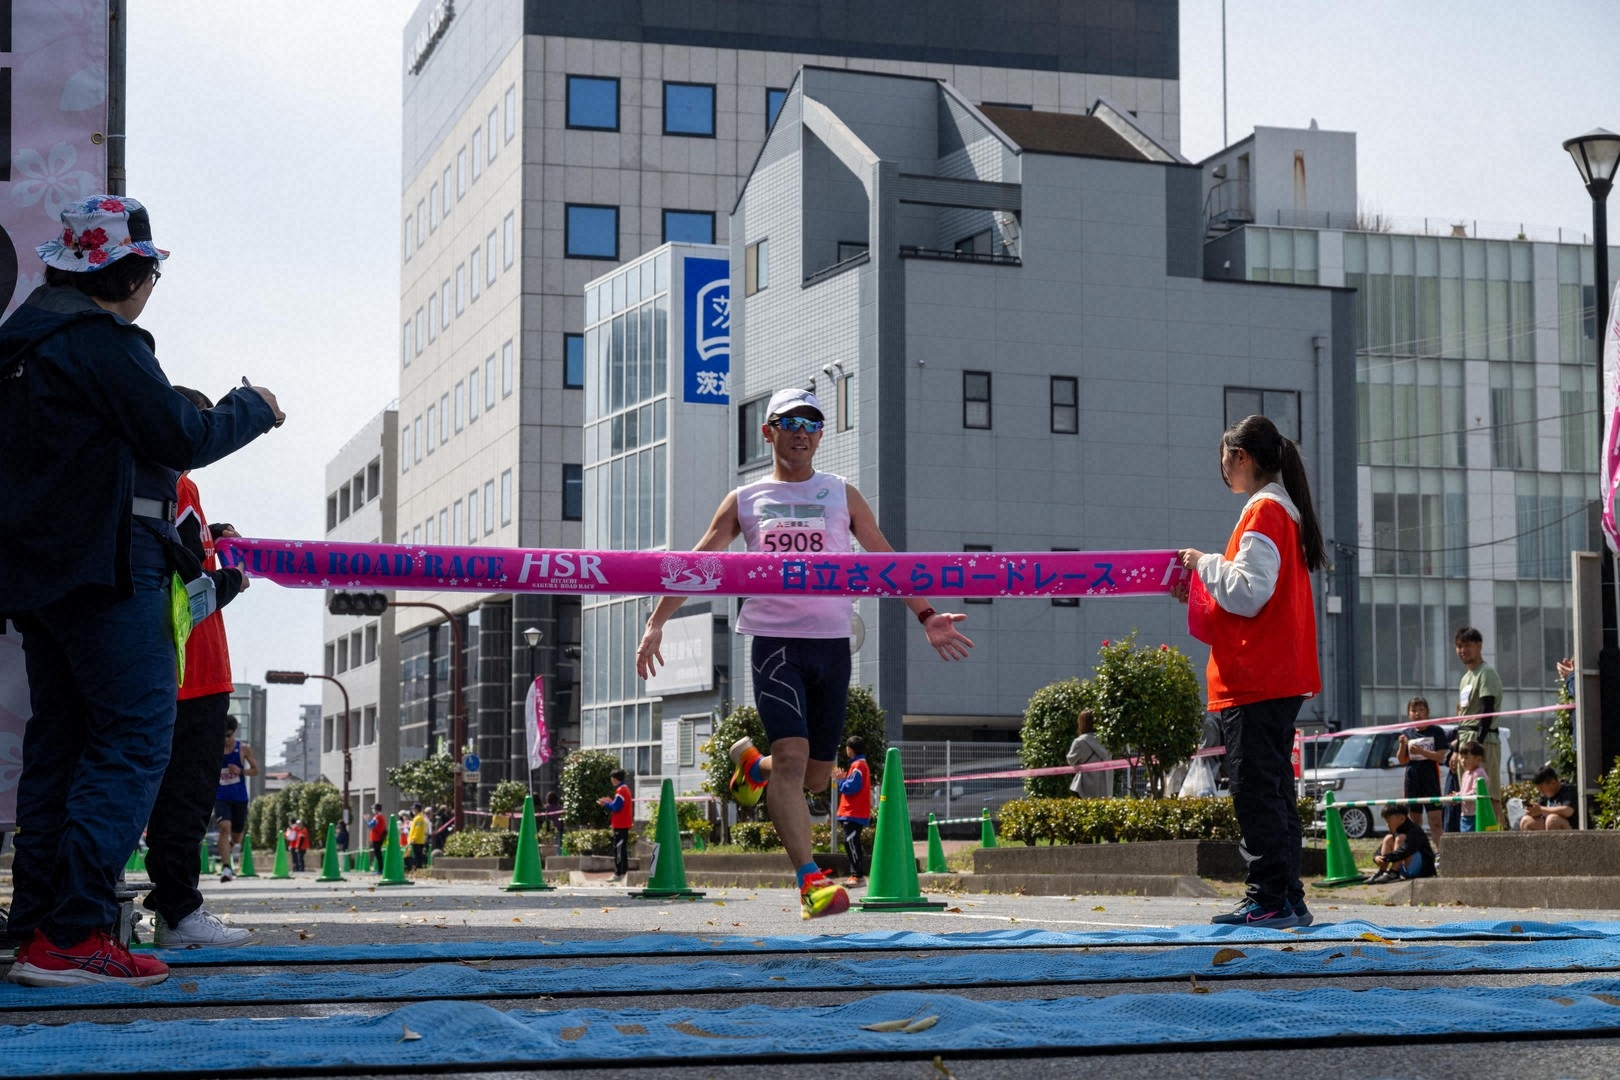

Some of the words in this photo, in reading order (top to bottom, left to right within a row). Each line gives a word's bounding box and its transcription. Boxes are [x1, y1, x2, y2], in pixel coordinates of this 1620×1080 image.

[763, 531, 824, 552] 5908
[327, 551, 415, 577] ROAD
[423, 554, 505, 580] RACE
[517, 552, 610, 585] HSR
[782, 560, 1116, 592] 日立さくらロードレース
